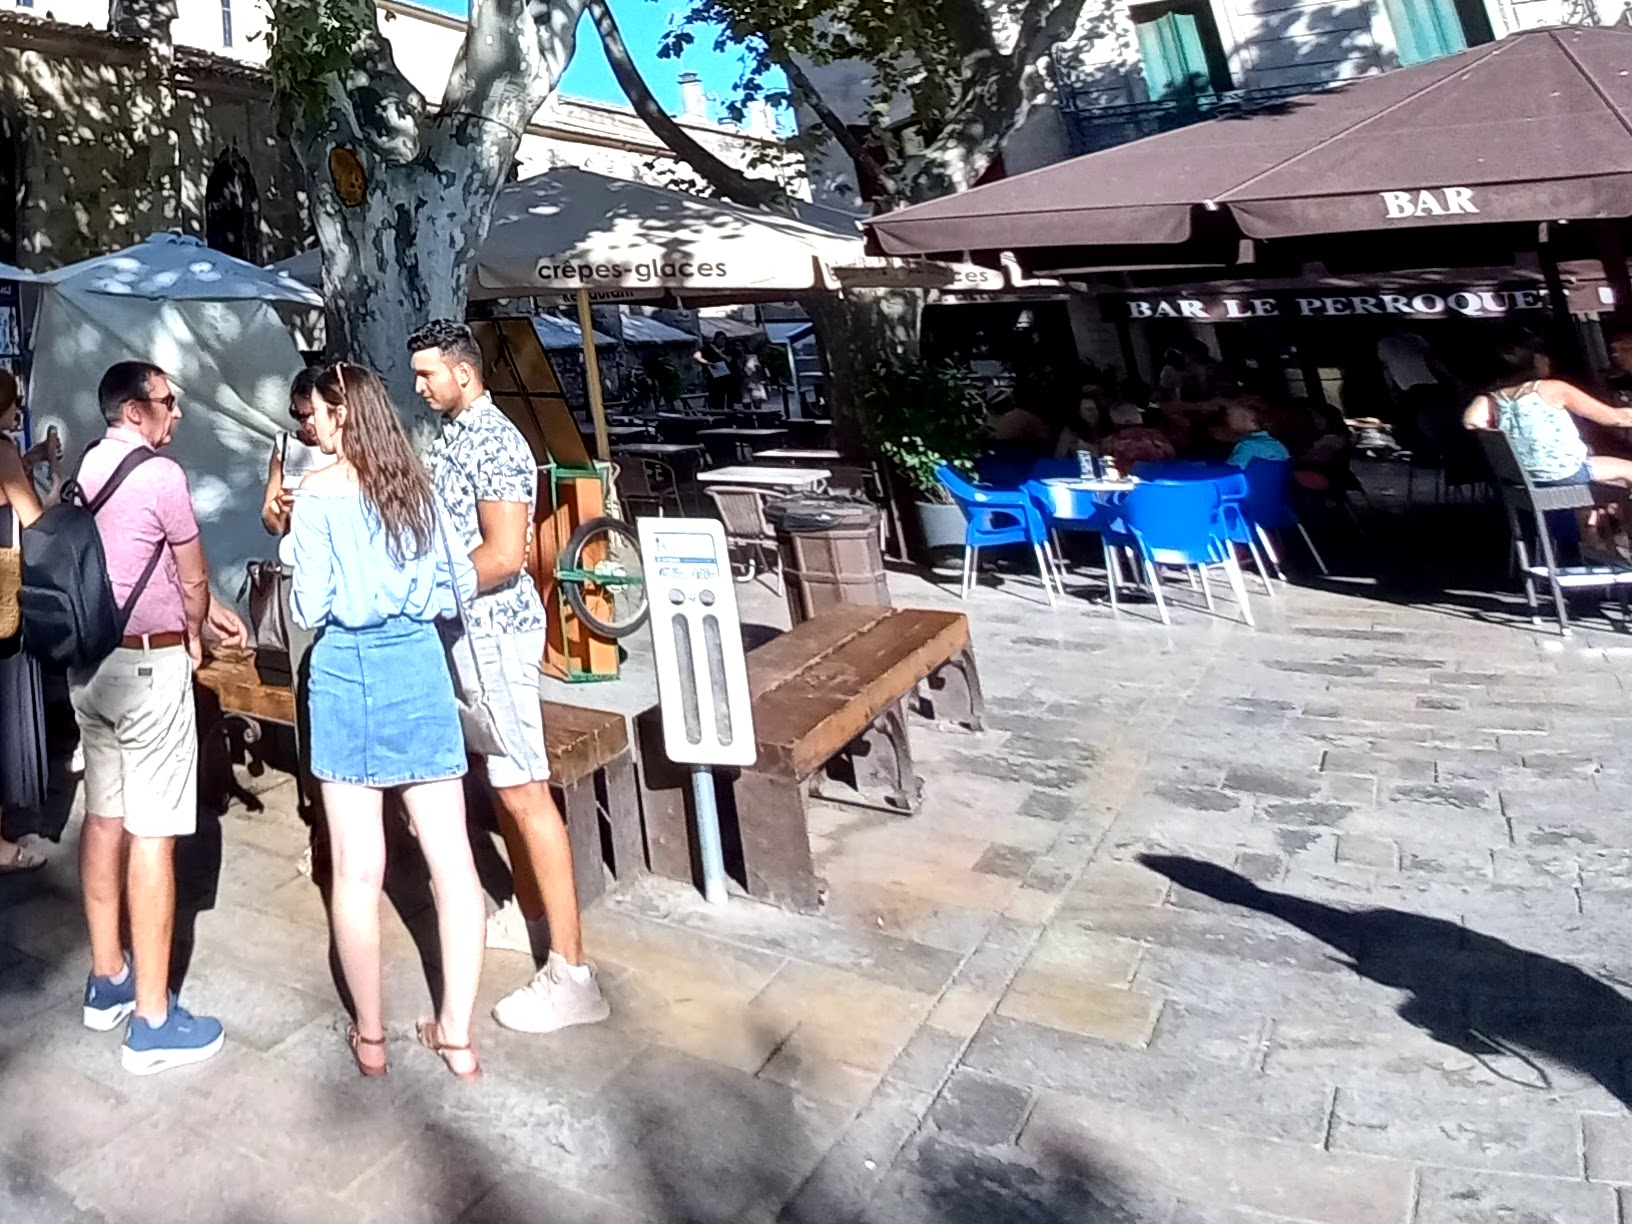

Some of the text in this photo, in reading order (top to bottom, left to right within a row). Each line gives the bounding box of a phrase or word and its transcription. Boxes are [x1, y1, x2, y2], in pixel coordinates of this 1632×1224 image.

[1379, 186, 1480, 219] BAR
[538, 258, 727, 283] crêpes-glaces
[1126, 299, 1210, 318] BAR
[1223, 298, 1280, 317] LE
